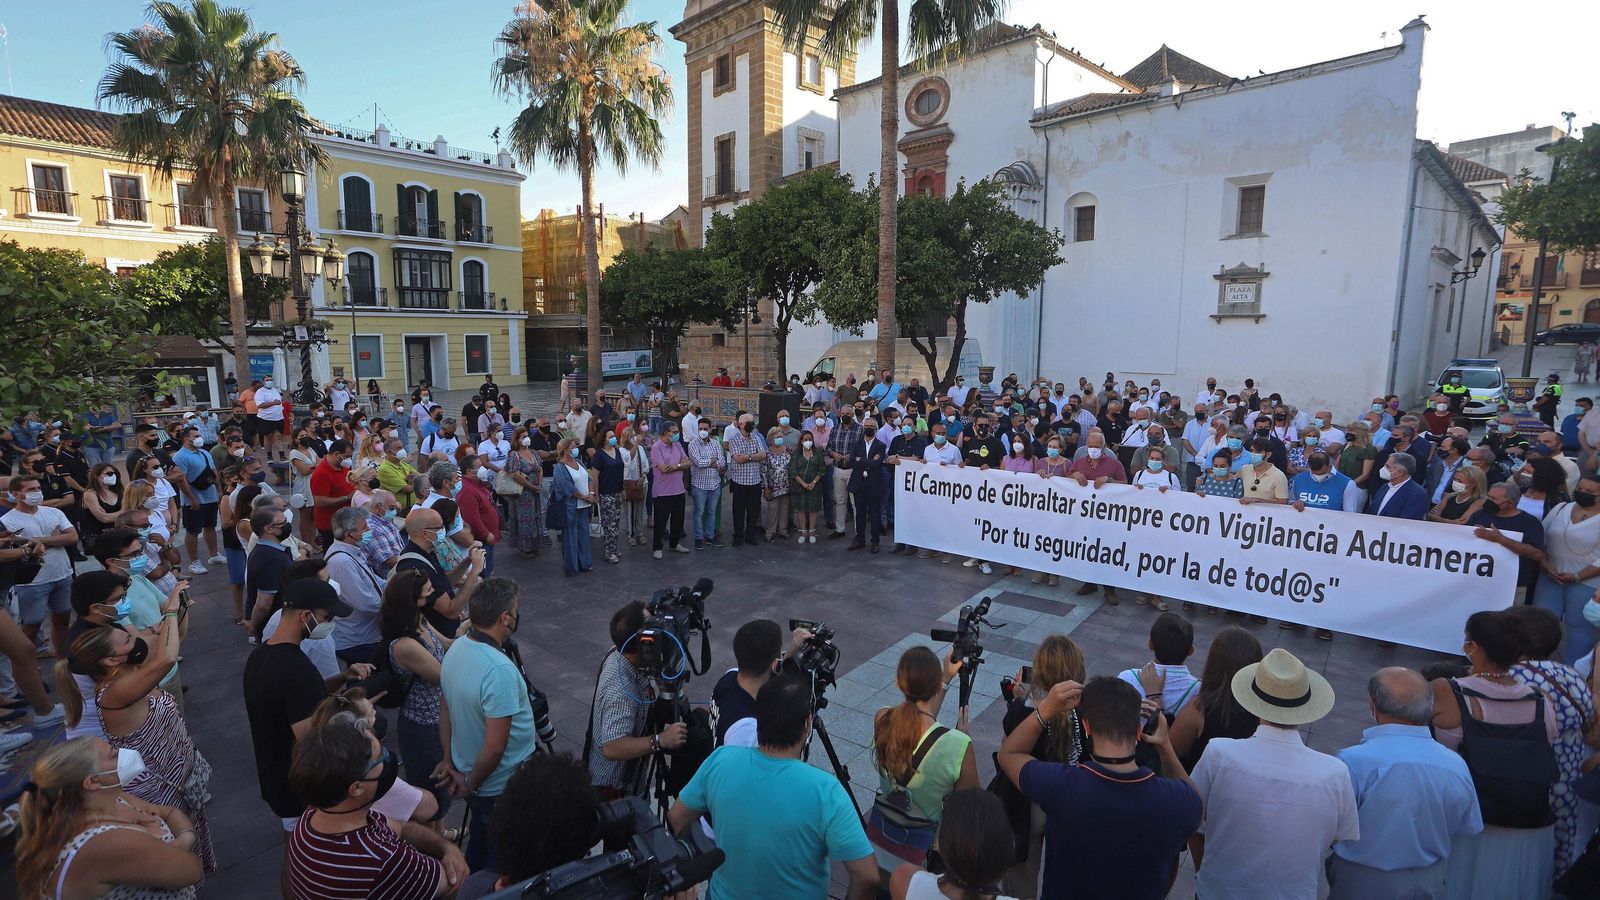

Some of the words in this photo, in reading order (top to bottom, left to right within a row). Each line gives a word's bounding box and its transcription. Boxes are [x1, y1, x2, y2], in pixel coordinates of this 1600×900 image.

[904, 470, 917, 493] El
[919, 473, 973, 505] Campo
[977, 479, 997, 504] de
[1001, 482, 1077, 518] Gibraltar
[1080, 493, 1164, 532] siempre
[1169, 512, 1210, 536] con
[1219, 511, 1339, 555] Vigilancia
[1345, 529, 1495, 578] Aduanera
[974, 517, 1009, 545] "Por
[1013, 526, 1030, 550] tu
[1034, 534, 1130, 572] seguridad,
[1136, 552, 1177, 578] por
[1181, 551, 1201, 582] la
[1208, 557, 1238, 588] de
[1245, 566, 1340, 604] tod@s"
